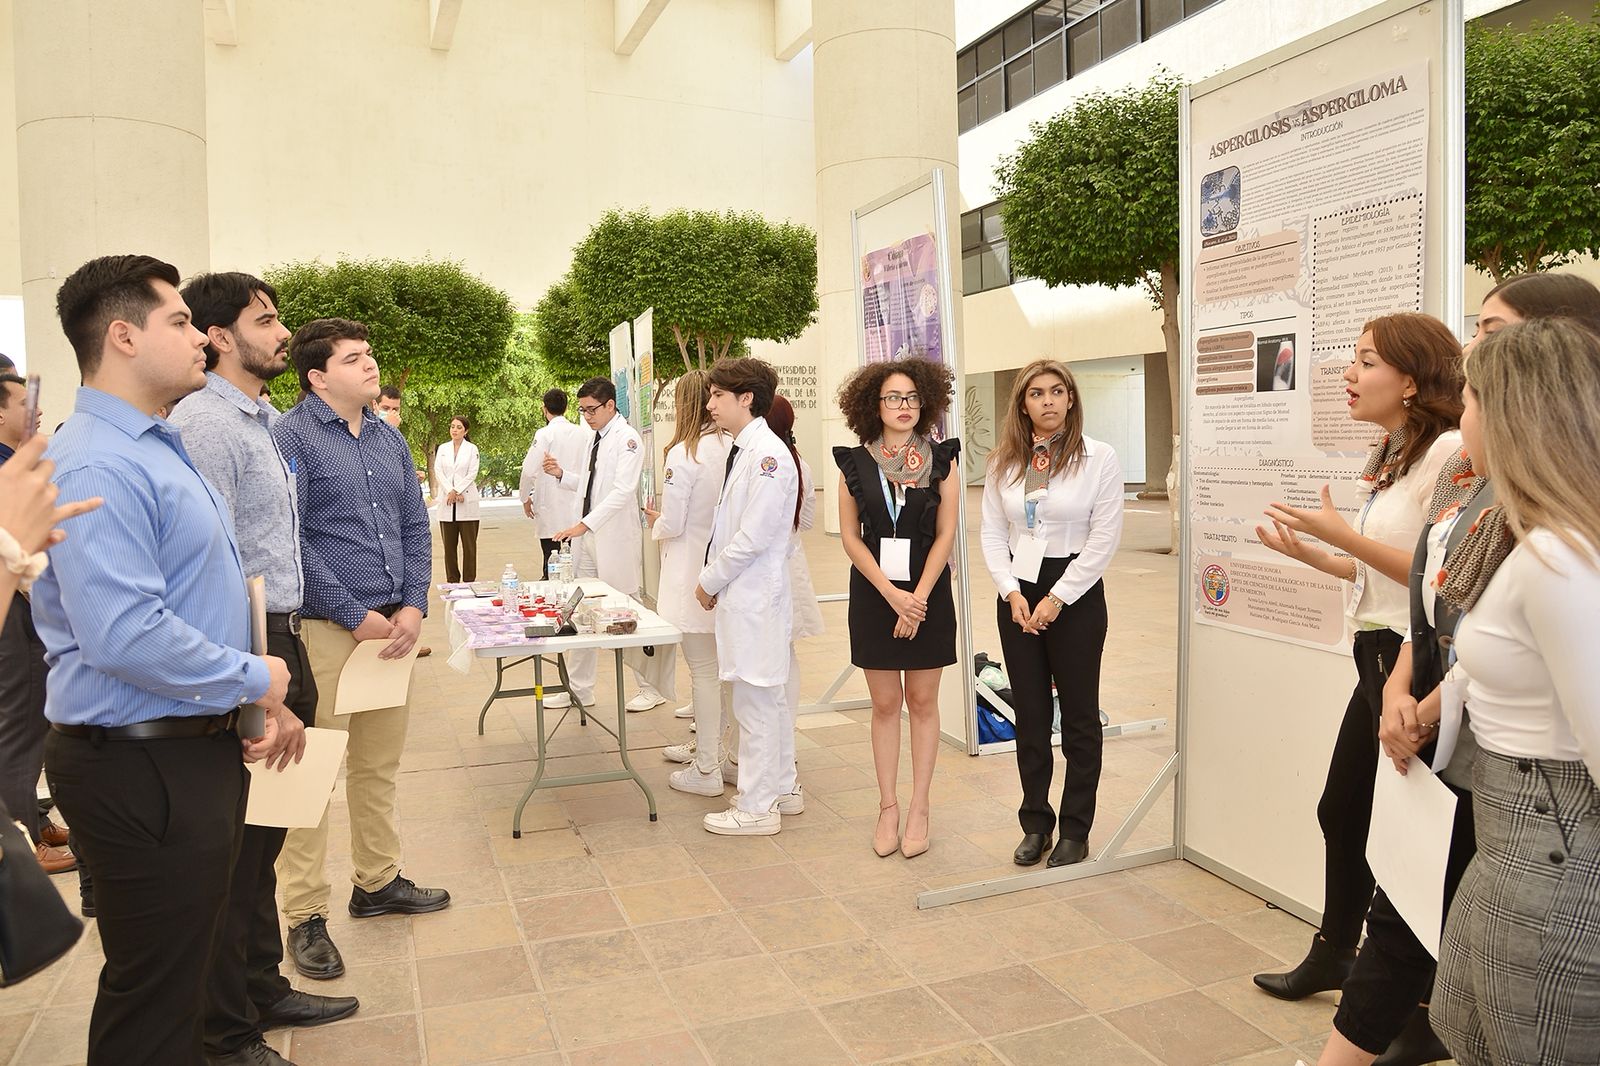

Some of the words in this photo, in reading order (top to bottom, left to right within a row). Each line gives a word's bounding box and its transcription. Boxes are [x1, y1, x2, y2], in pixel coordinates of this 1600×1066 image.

[1208, 117, 1292, 160] ASPERGILOSIS
[1300, 75, 1408, 126] ASPERGILOMA
[1300, 120, 1344, 142] INTRODUCCIÓN
[1341, 207, 1389, 226] EPIDEMIOLOGÍA
[1339, 251, 1359, 260] pulmonar
[1353, 269, 1373, 278] Mycology
[1240, 310, 1254, 319] TIPOS
[809, 366, 816, 374] DE
[786, 377, 800, 385] TIENE
[802, 377, 817, 385] POR
[795, 389, 803, 397] DE
[807, 389, 816, 397] LAS
[809, 400, 816, 408] DE
[1259, 459, 1294, 467] DIAGNÓSTICO
[1204, 532, 1237, 543] TRATAMIENTO
[1230, 562, 1257, 570] UNIVERSIDAD
[1230, 569, 1251, 577] DIRECCIÓN
